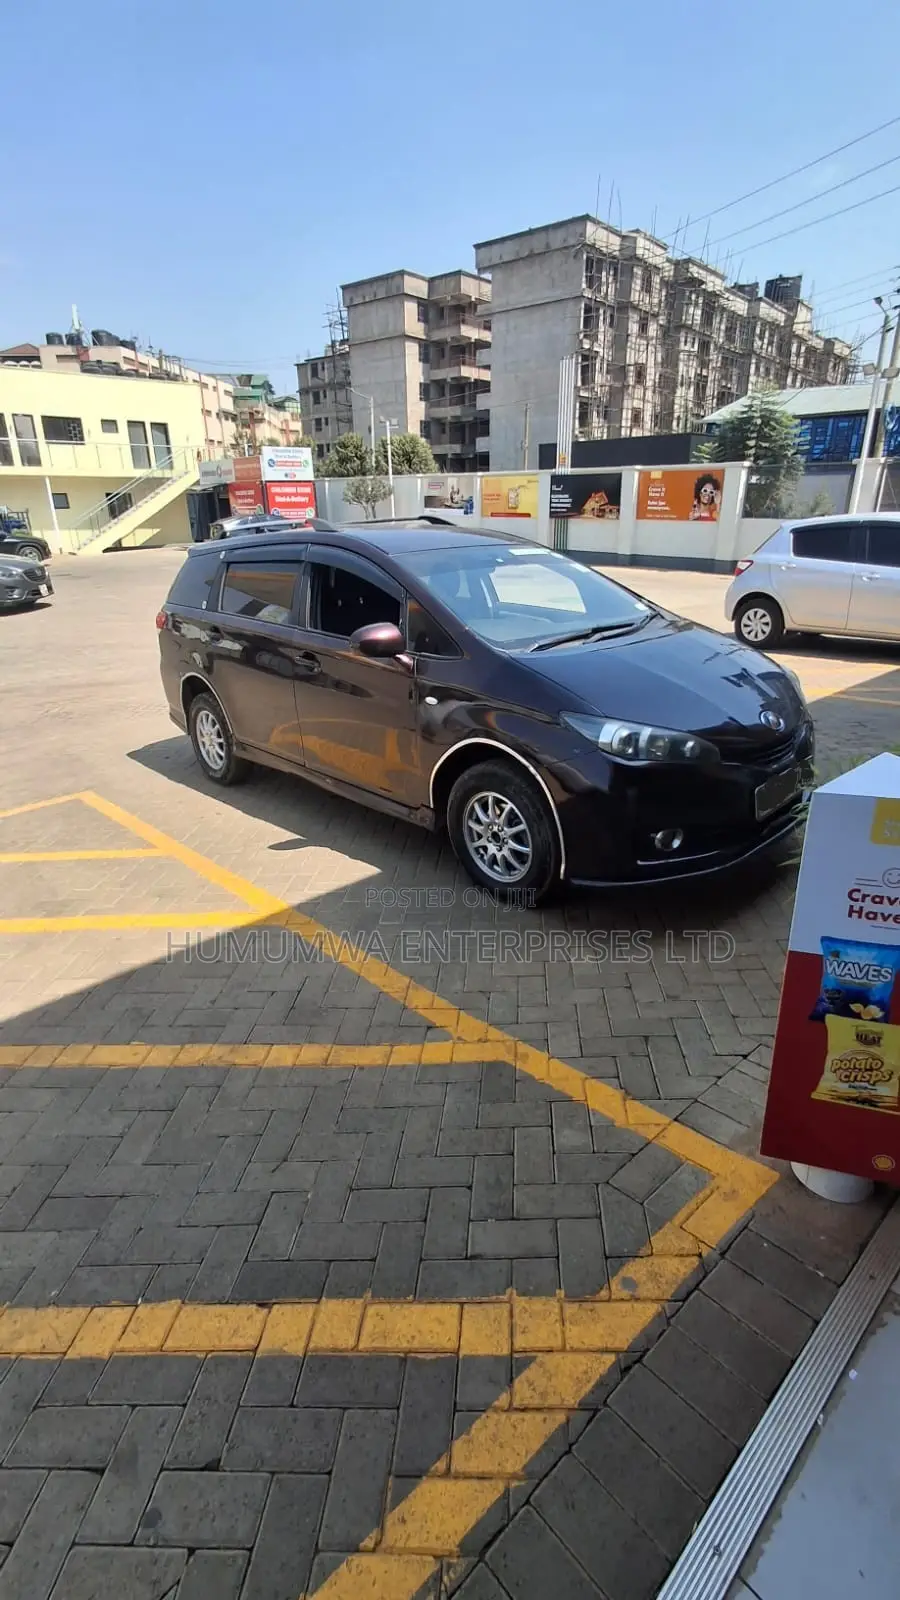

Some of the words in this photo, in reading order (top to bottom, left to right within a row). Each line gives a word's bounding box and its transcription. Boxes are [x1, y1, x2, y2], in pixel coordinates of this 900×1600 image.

[847, 888, 900, 906] Crav
[825, 959, 893, 983] WAVES
[831, 1056, 884, 1073] potato
[838, 1067, 893, 1085] crisps
